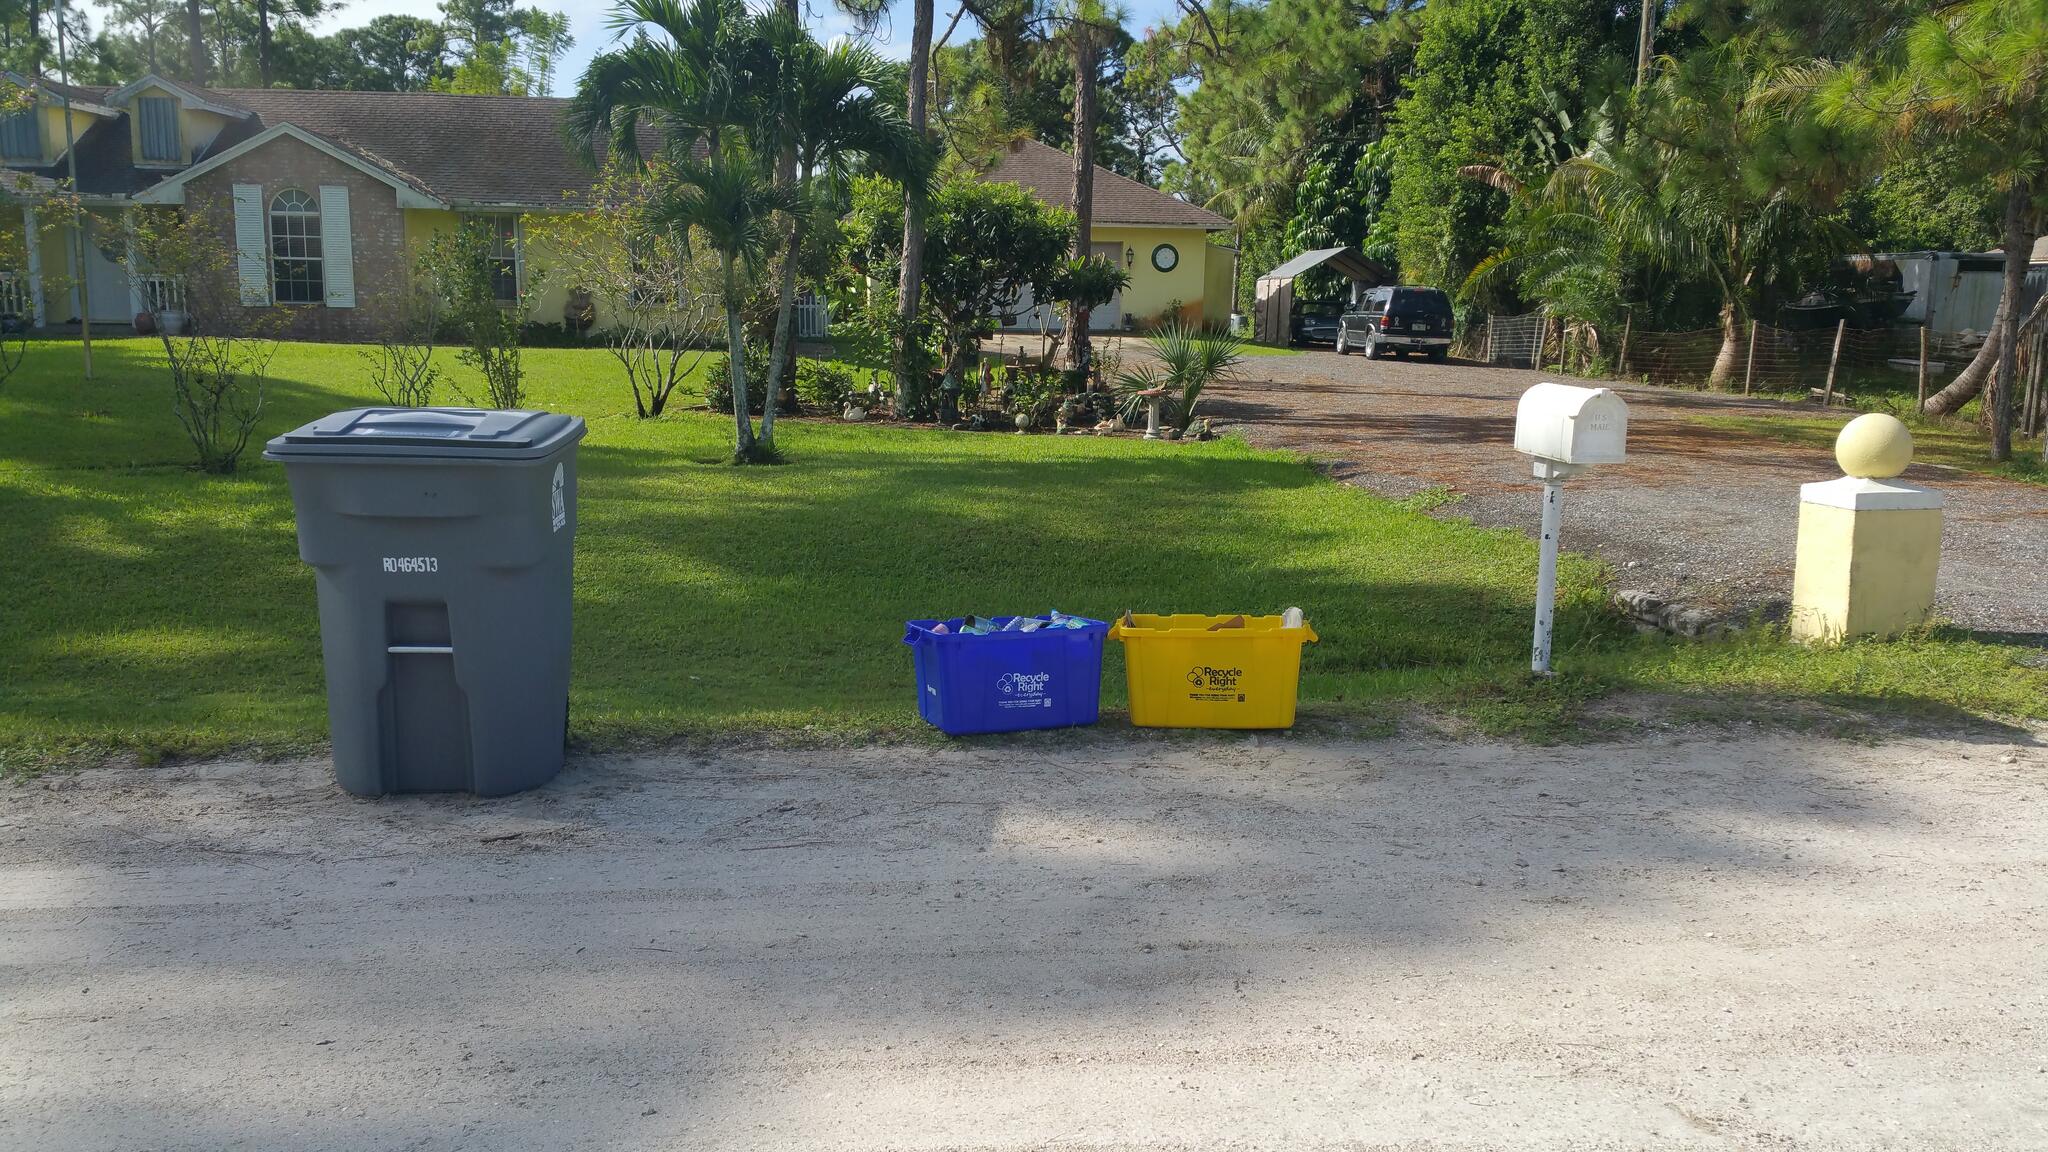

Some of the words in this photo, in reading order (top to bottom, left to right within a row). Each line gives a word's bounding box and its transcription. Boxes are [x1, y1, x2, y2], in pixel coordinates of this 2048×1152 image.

[1590, 424, 1611, 432] MAIL
[1204, 666, 1242, 678] Recycle
[1013, 672, 1050, 684] Recycle
[1209, 676, 1237, 687] Right
[1018, 682, 1044, 692] Right
